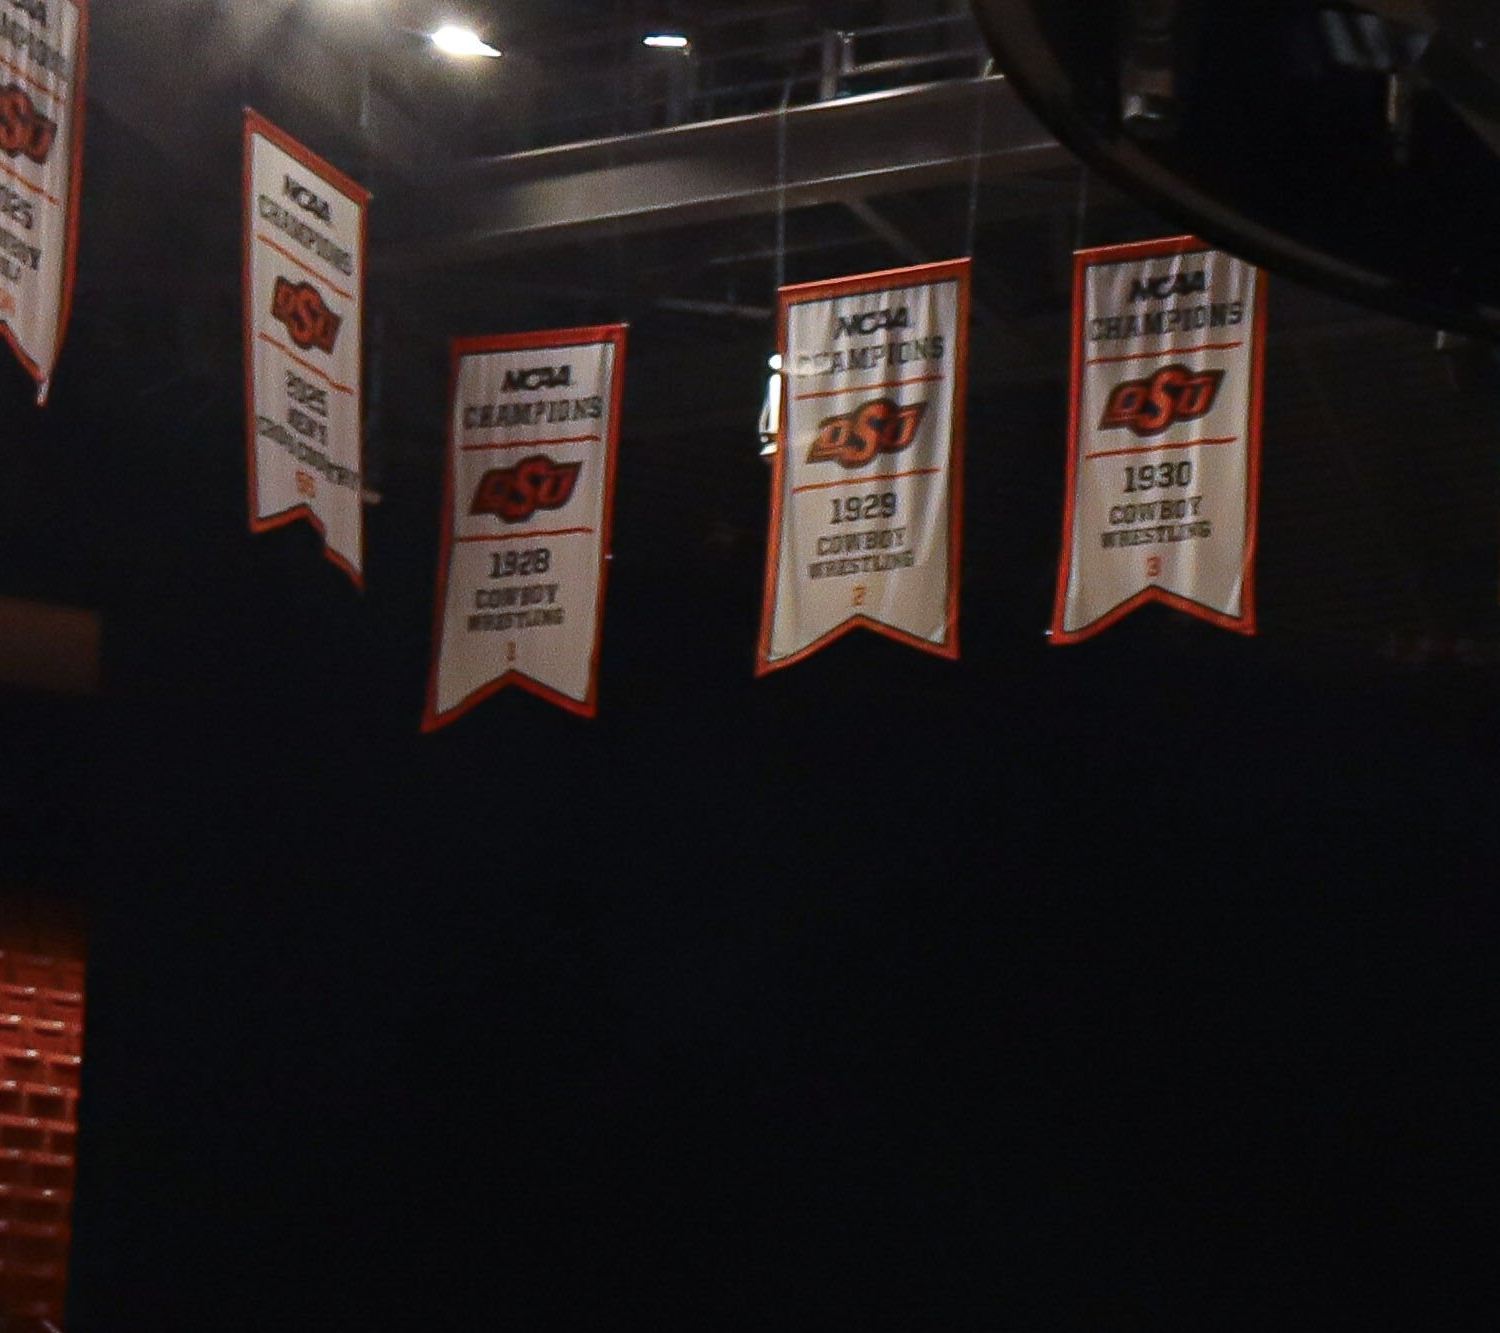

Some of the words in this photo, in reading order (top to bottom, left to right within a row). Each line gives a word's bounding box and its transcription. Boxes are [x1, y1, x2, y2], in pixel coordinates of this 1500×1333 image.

[1129, 270, 1205, 302] NCAA
[834, 307, 908, 340] NCAA
[1092, 302, 1244, 341] CHAMPIONS
[798, 335, 944, 379] CHAMPIONS
[503, 365, 571, 392] NCAA
[464, 396, 602, 430] CHAMPIONS
[1097, 362, 1226, 437] OSU
[805, 397, 927, 468] OSU
[469, 454, 583, 524] OSU
[1123, 461, 1192, 493] 1930
[830, 492, 897, 526] 1929
[1108, 495, 1202, 525] COWBOY
[817, 526, 907, 557] COWBOY
[1101, 520, 1212, 549] WRESTLING
[490, 548, 550, 579] 1928
[808, 550, 915, 579] WRESTLING
[1147, 556, 1161, 577] 3
[476, 583, 558, 609] COWBOY
[853, 584, 867, 606] 2
